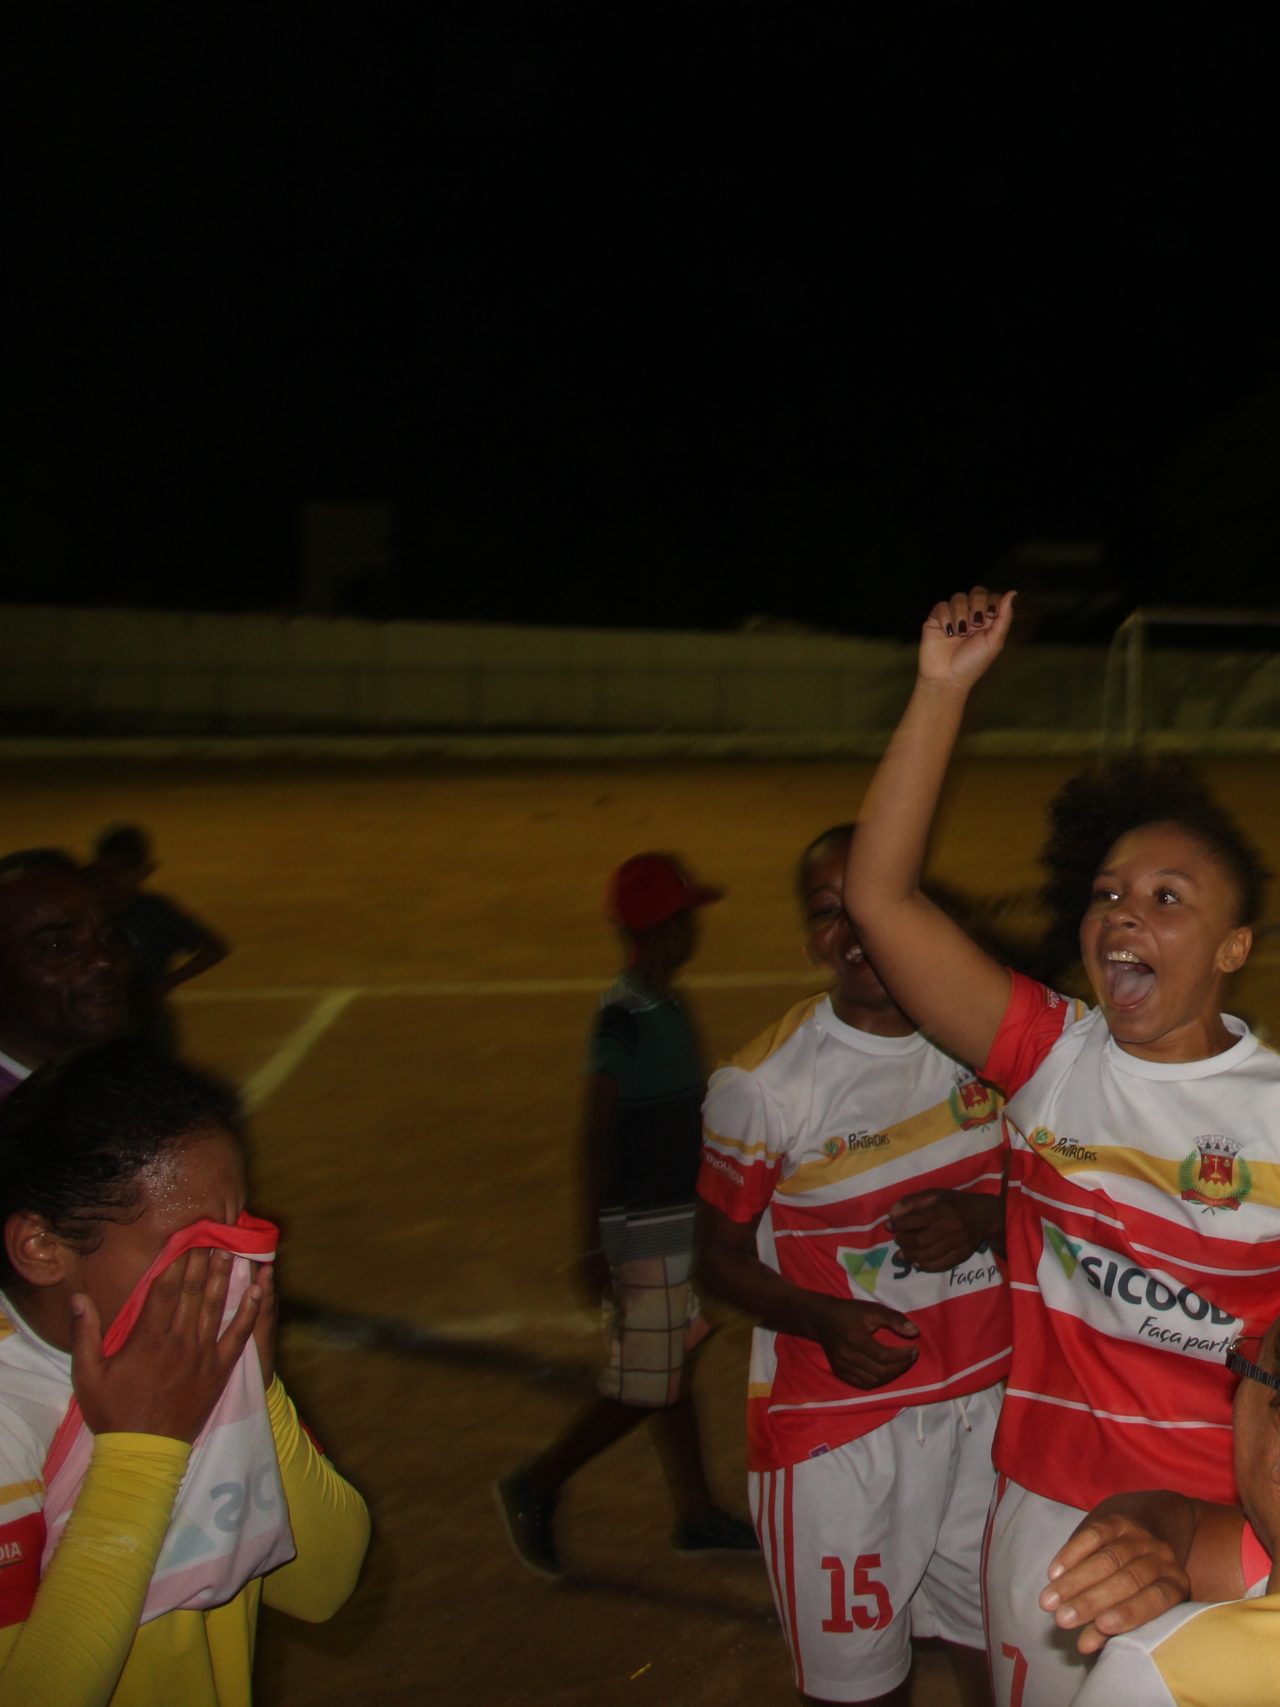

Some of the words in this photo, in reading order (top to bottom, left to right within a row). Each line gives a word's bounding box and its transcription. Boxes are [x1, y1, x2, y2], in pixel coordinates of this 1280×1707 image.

[1051, 1137, 1098, 1161] PINTADAS
[1138, 1316, 1182, 1345] Faça
[820, 1553, 894, 1634] 15
